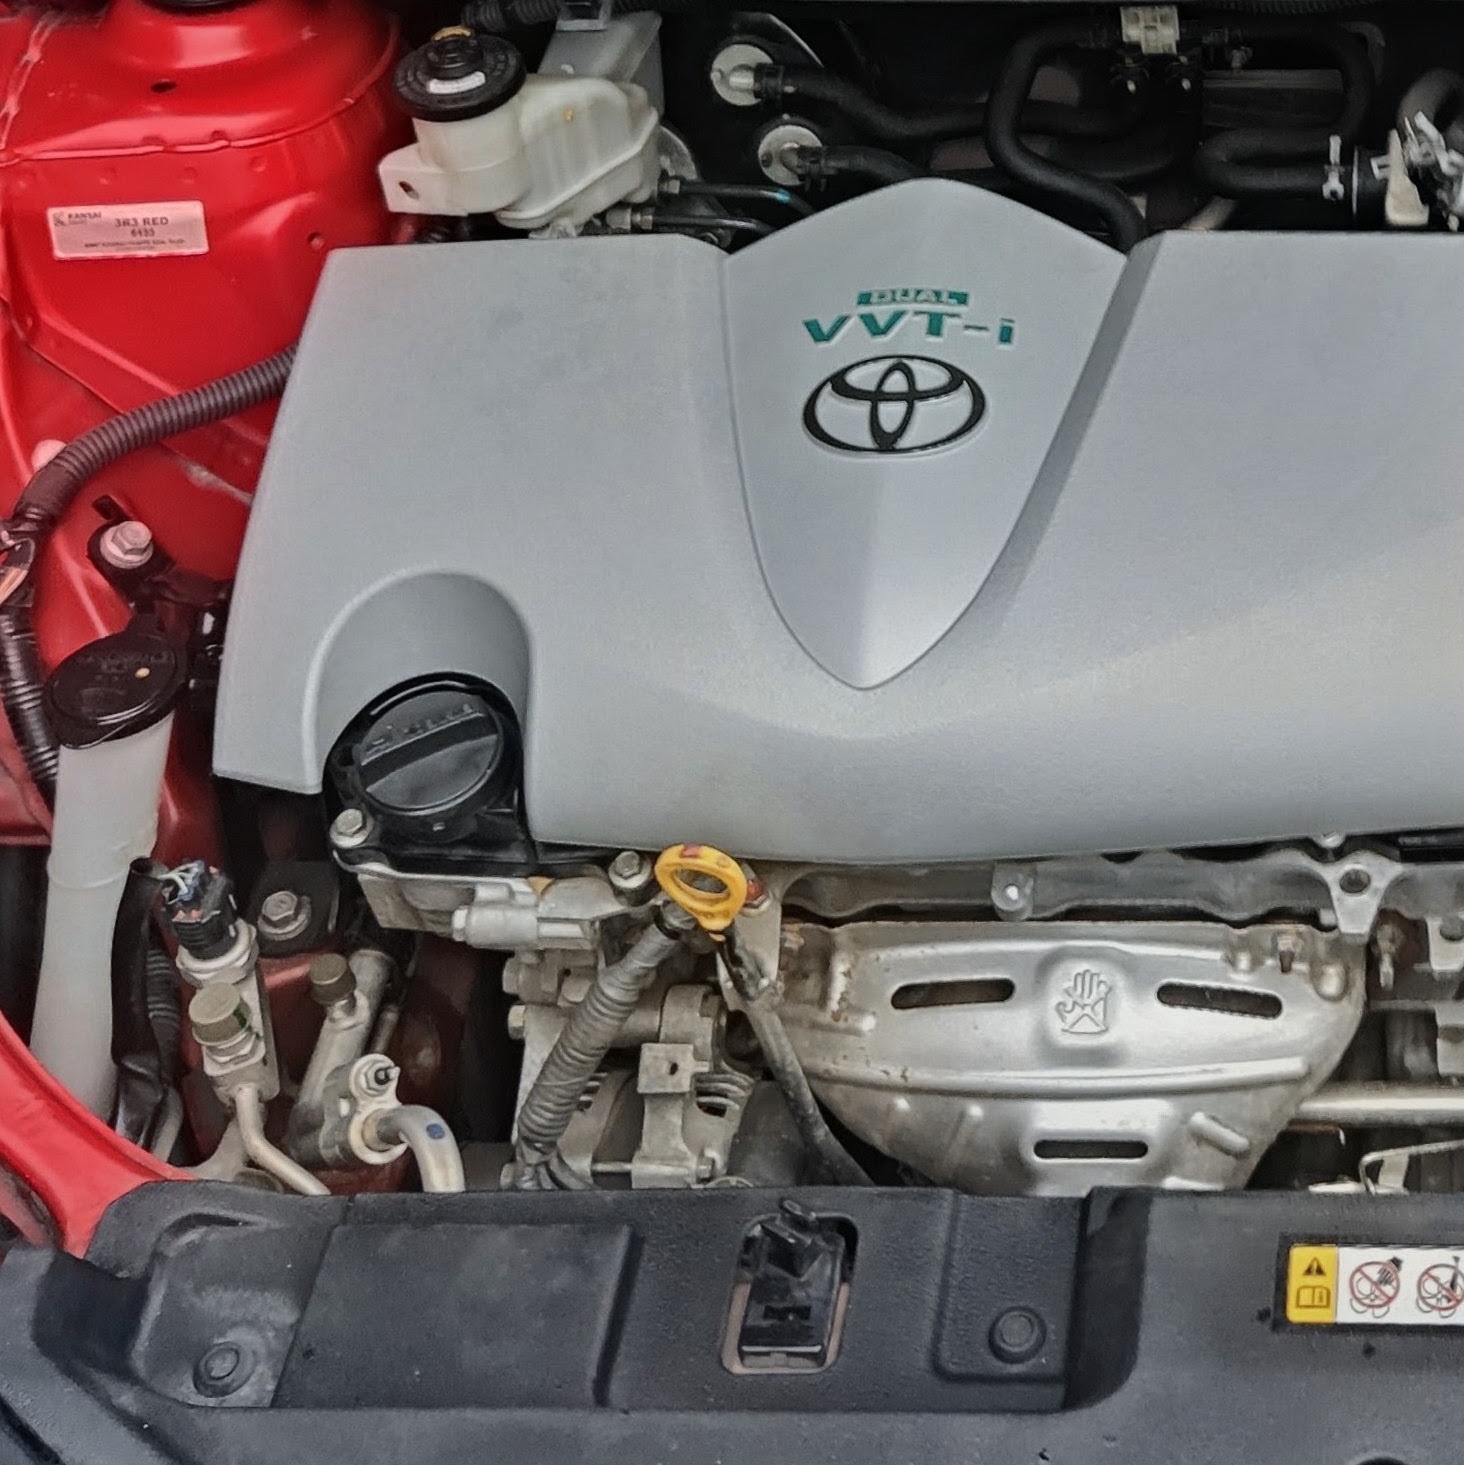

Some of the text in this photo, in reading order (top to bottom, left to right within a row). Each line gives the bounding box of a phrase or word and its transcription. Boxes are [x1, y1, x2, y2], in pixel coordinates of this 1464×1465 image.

[143, 216, 169, 226] RED
[867, 289, 960, 305] DUAL
[803, 310, 1015, 345] VVT-i
